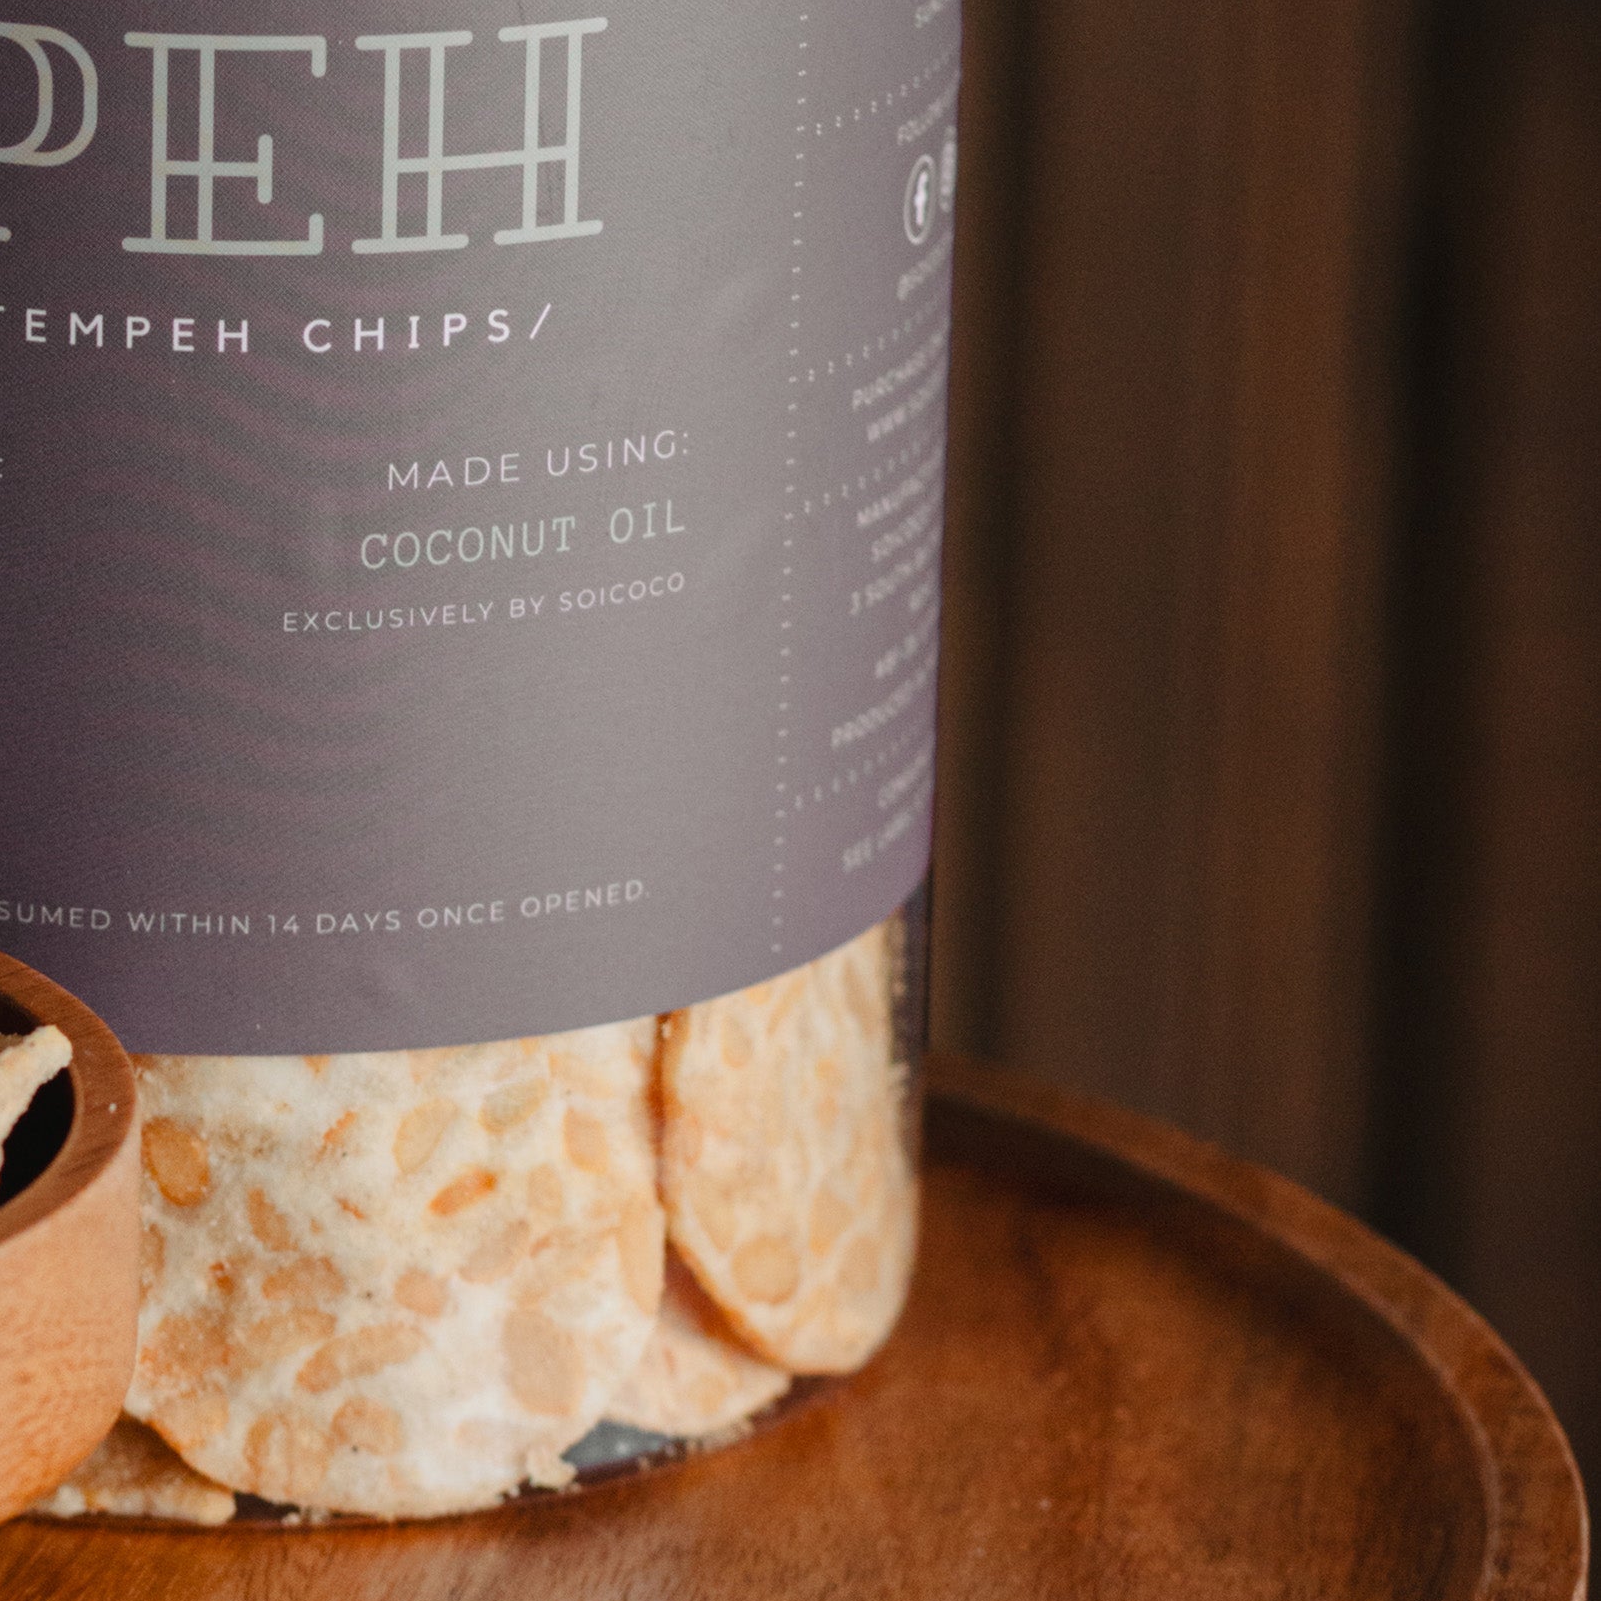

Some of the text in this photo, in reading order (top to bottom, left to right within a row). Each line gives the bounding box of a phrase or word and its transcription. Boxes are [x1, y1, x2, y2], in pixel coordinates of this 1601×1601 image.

[387, 429, 690, 492] MADE USING:
[359, 498, 687, 571] COCONUT OIL
[282, 571, 687, 633] EXCLUSIVELY BY SOICOCO
[126, 910, 251, 936] WITHIN
[267, 913, 301, 936] 14
[315, 909, 402, 936] DAYS
[416, 899, 505, 930] ONCE
